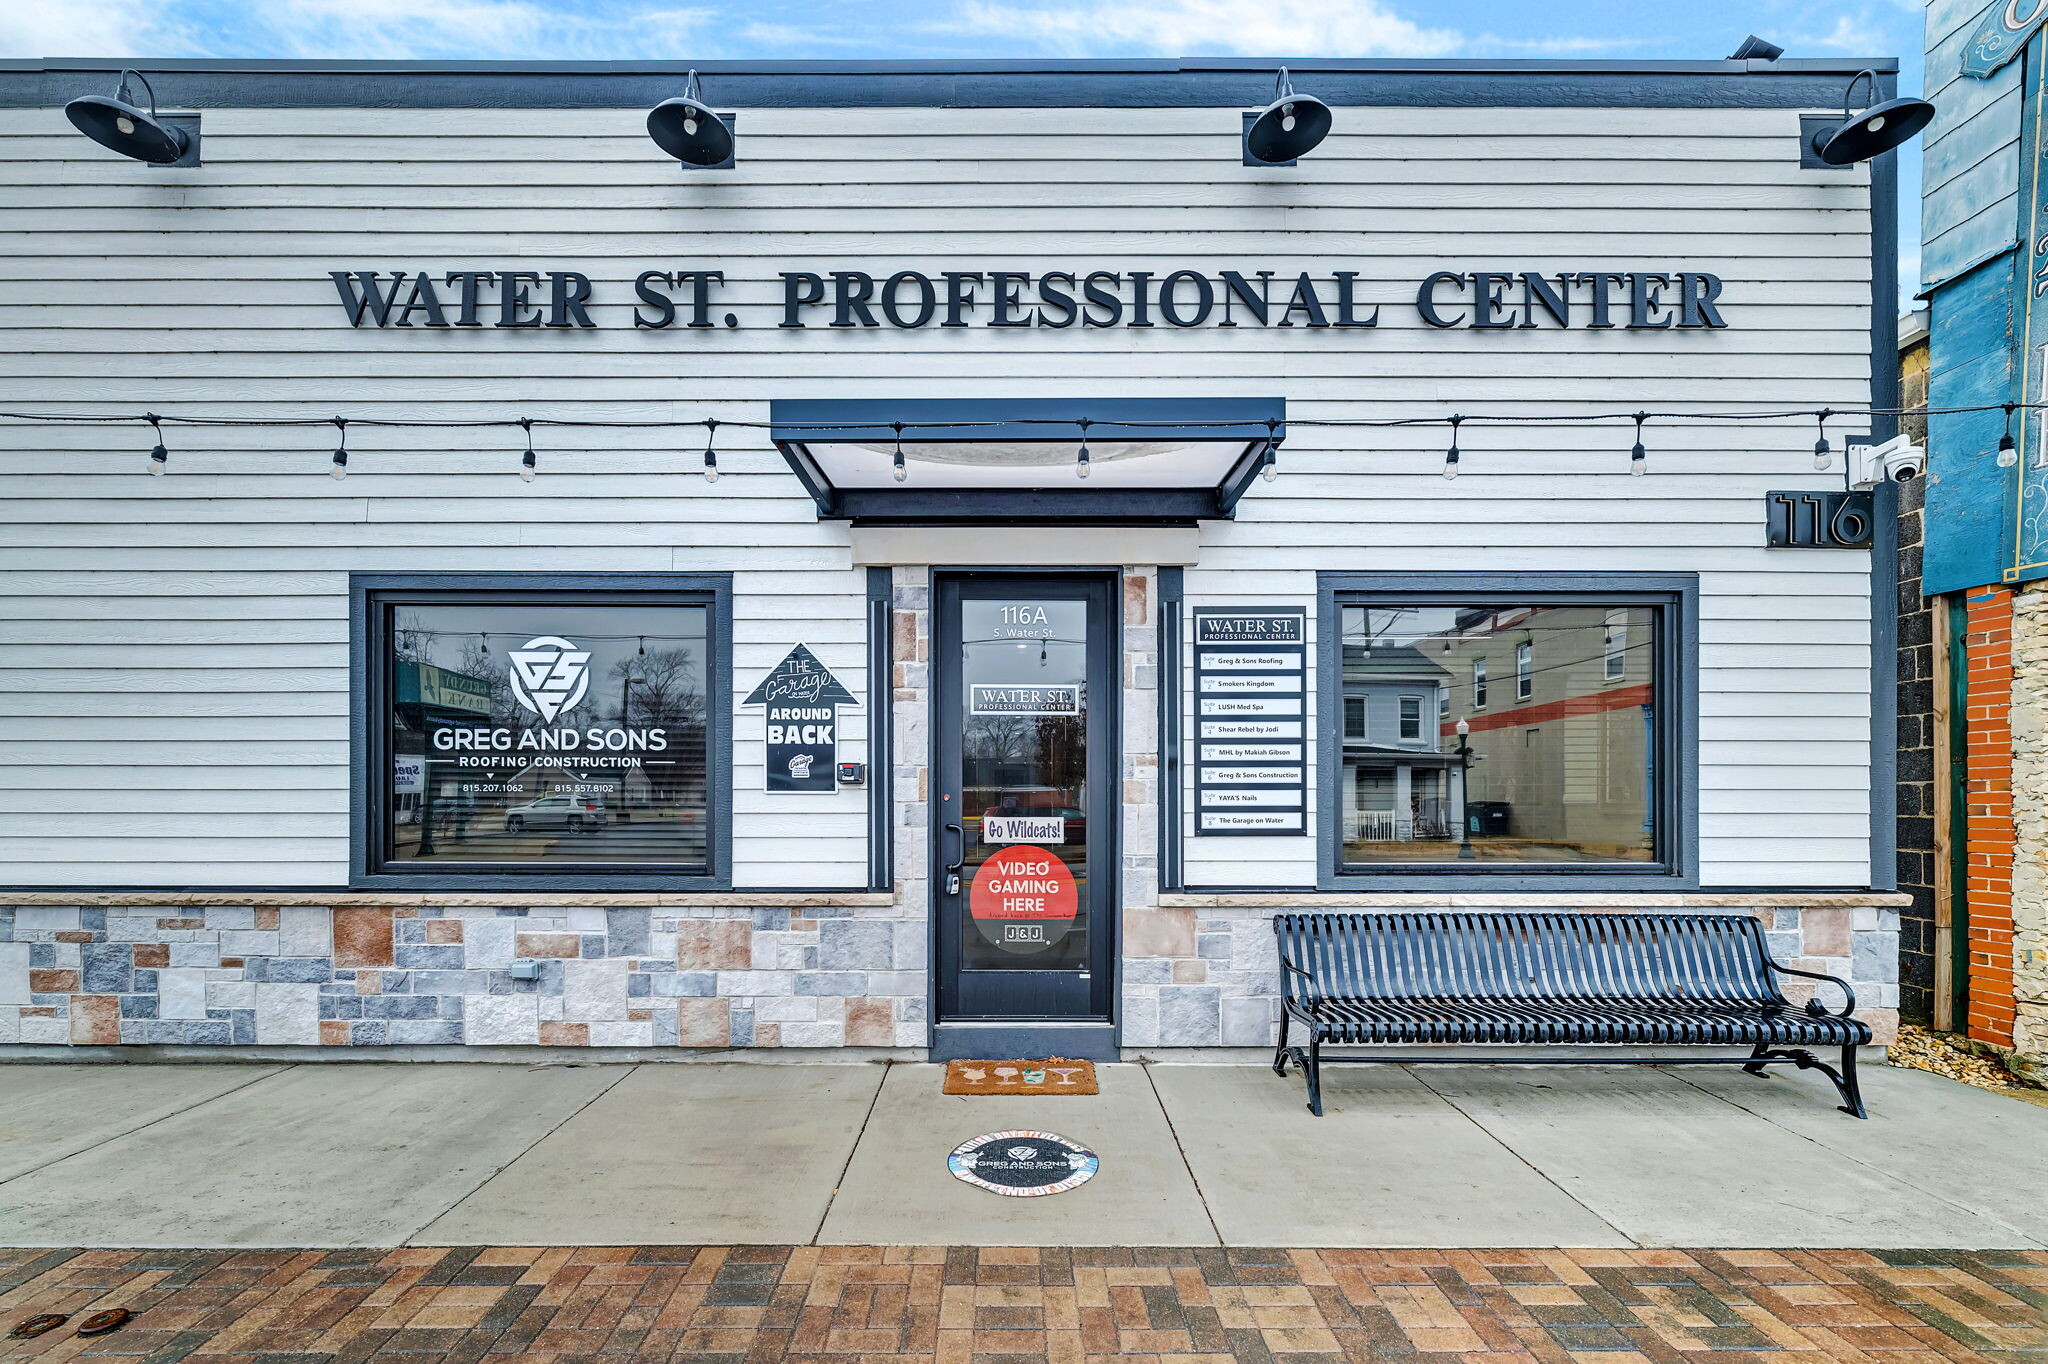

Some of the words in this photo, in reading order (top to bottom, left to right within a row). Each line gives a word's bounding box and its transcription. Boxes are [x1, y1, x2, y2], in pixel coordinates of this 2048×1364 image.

[328, 270, 598, 329] WATER
[633, 269, 740, 329] ST.
[777, 269, 1380, 329] PROFESSIONAL
[1416, 270, 1729, 329] CENTER
[1775, 493, 1872, 545] 116
[1000, 606, 1048, 625] 116A
[1207, 619, 1267, 633] WATER
[1272, 619, 1294, 633] ST.
[993, 628, 1003, 638] S.
[1006, 628, 1039, 638] Water
[1042, 628, 1056, 638] St.
[787, 659, 812, 674] THE
[1217, 657, 1234, 666] Greg
[1258, 657, 1283, 666] Roofing
[765, 671, 832, 703] Garage
[1246, 680, 1275, 688] Kingdom
[981, 690, 1042, 703] WATER
[1047, 690, 1069, 703] ST.
[1040, 703, 1072, 711] CENTER
[769, 708, 832, 721] AROUND
[767, 724, 834, 745] BACK
[1256, 726, 1264, 734] by
[433, 727, 512, 751] GREG
[516, 728, 580, 751] AND
[586, 727, 668, 751] SONS
[1235, 749, 1243, 757] by
[459, 756, 528, 767] ROOFING
[534, 756, 642, 768] CONSTRUCTION
[1218, 772, 1234, 780] Greg
[462, 783, 524, 793] 815.207.1062
[554, 783, 614, 793] 815.557.8102
[1232, 817, 1254, 825] Garage
[988, 820, 1003, 838] Go
[1006, 820, 1061, 839] Wildcats!
[997, 860, 1050, 876] VIDEO
[988, 880, 1060, 894] GAMING
[1003, 897, 1045, 912] HERE
